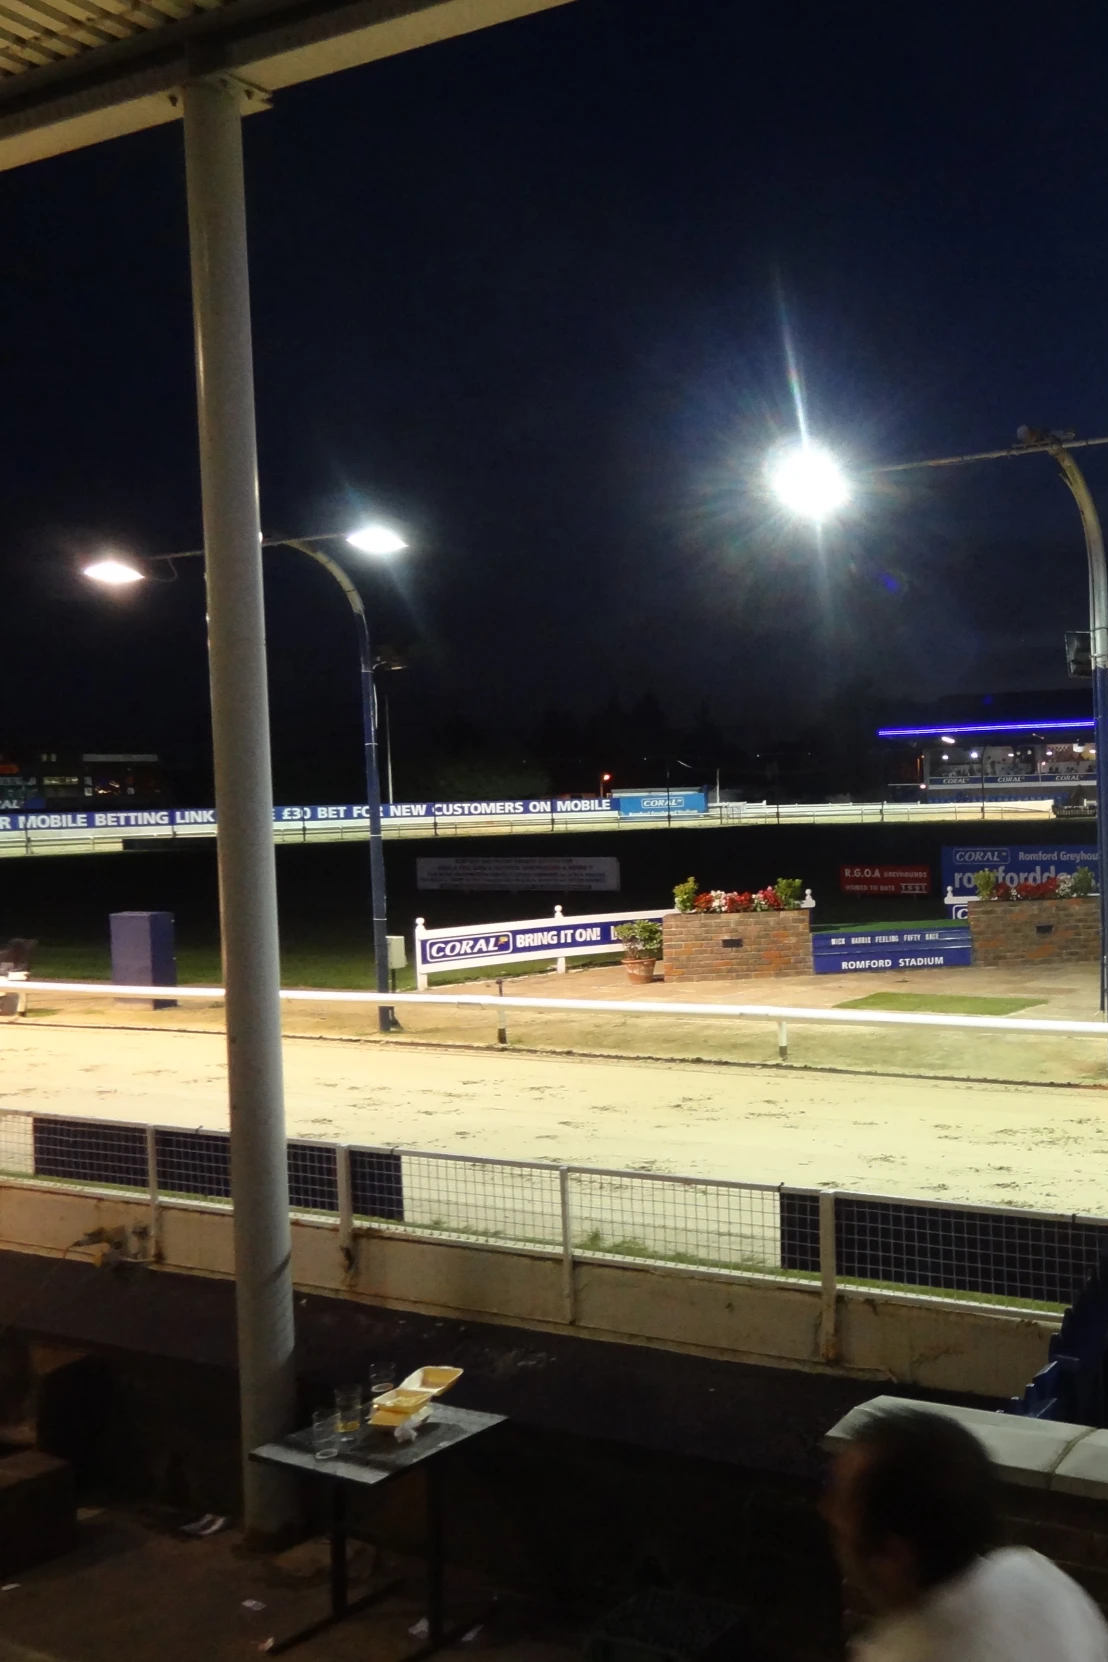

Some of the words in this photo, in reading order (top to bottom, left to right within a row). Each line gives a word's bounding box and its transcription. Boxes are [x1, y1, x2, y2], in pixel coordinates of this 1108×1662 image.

[282, 807, 312, 820] £30
[317, 806, 347, 819] BET
[389, 803, 427, 817] NEW
[433, 801, 524, 816] CUSTOMERS
[529, 801, 551, 814] ON
[557, 799, 612, 811] MOBILE
[643, 799, 677, 807] CORAL
[18, 813, 88, 829] MOBILE
[94, 811, 170, 827] BETTING
[175, 809, 216, 825] LINK
[956, 850, 1001, 862] CORAL
[1019, 850, 1057, 861] Romford
[1060, 850, 1099, 863] Greyhou
[431, 936, 499, 958] CORAL
[516, 930, 558, 948] BRING
[560, 929, 574, 944] IT
[575, 927, 601, 942] ON!
[875, 935, 899, 943] FEELING
[841, 959, 892, 970] ROMFORD
[898, 956, 944, 967] STADIUM
